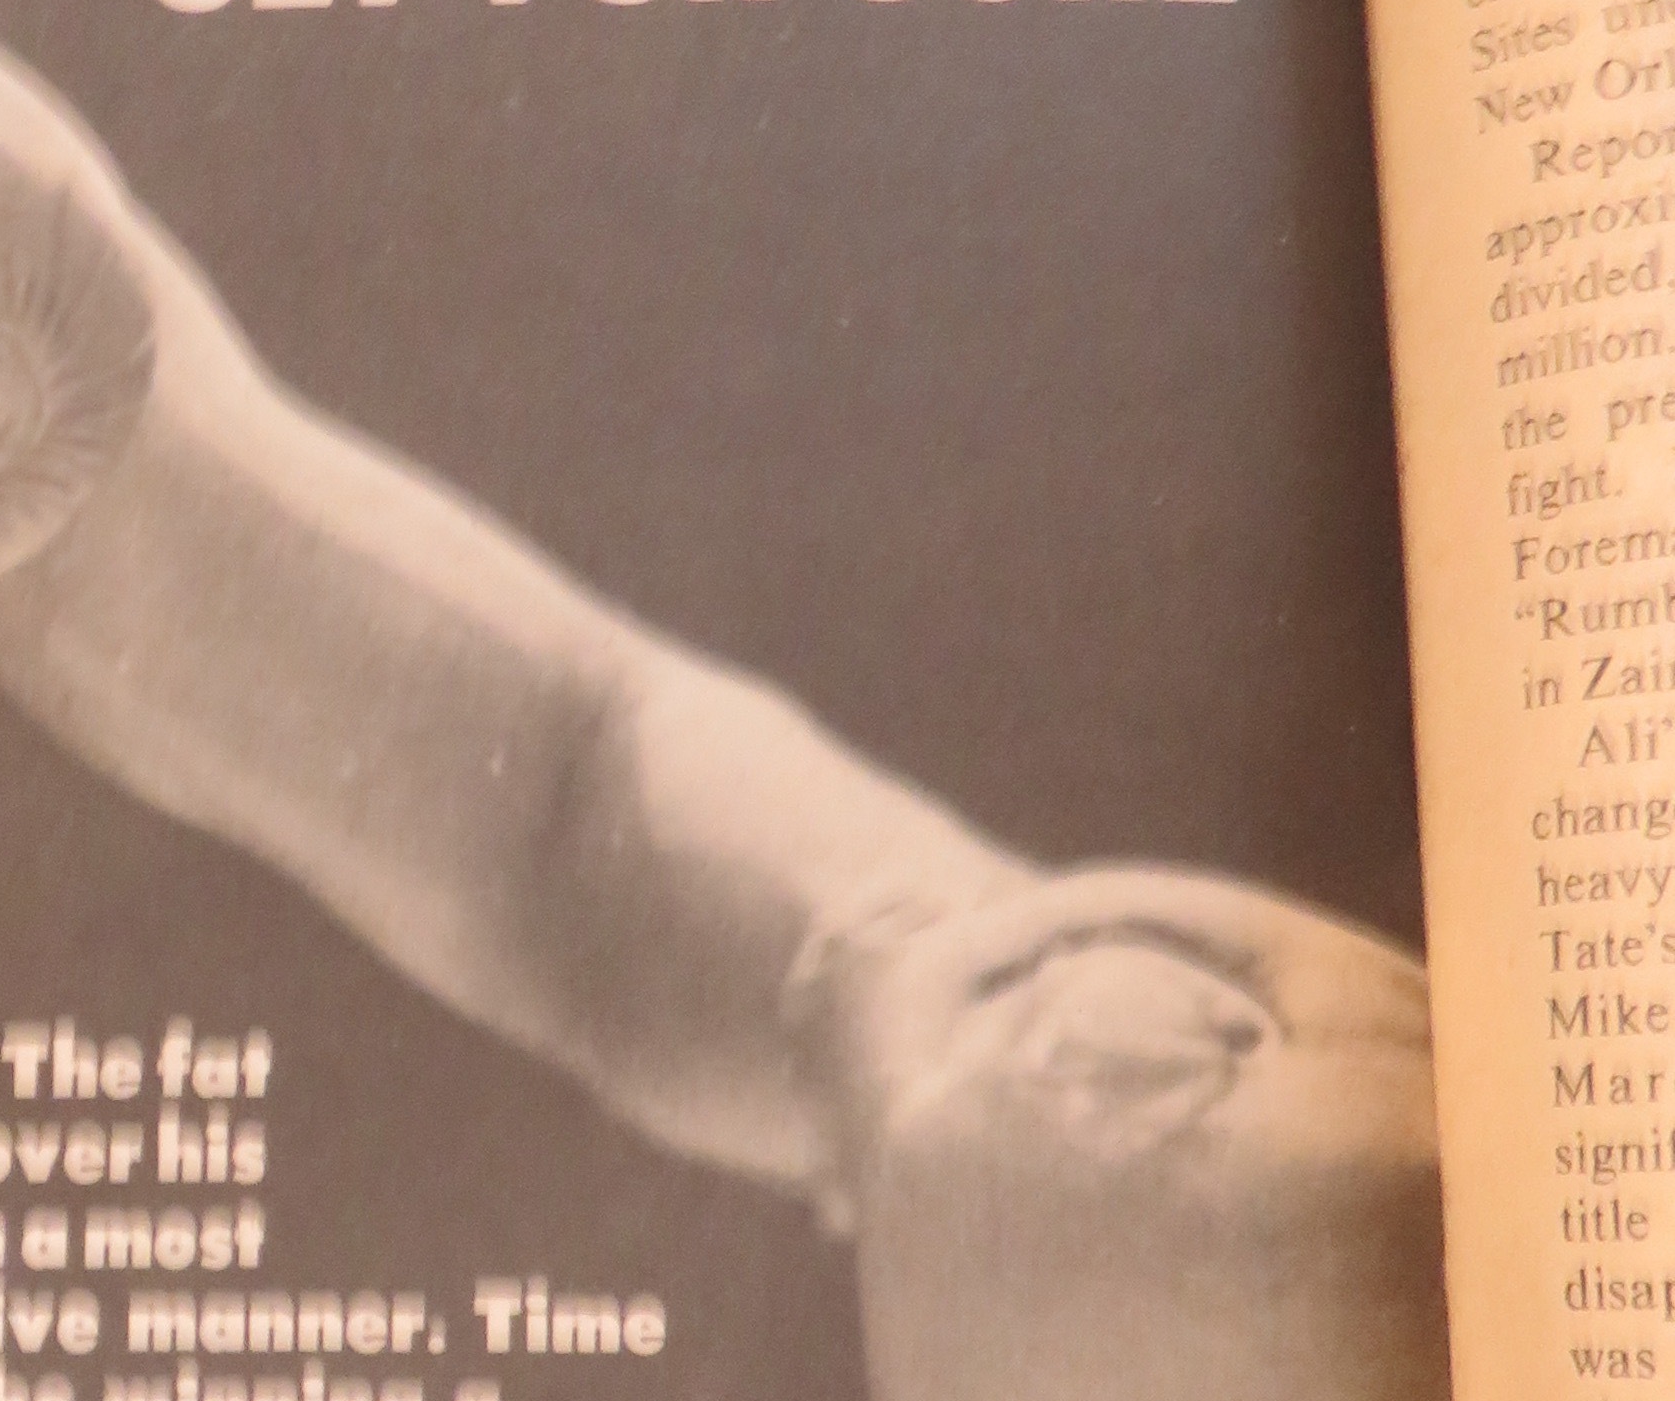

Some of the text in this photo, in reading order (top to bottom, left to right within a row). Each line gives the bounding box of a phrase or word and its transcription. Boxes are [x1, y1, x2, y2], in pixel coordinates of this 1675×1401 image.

[1471, 15, 1577, 74] Sites
[1472, 83, 1574, 135] New
[1502, 406, 1568, 450] the
[1507, 462, 1622, 522] fight.
[1522, 667, 1562, 710] in
[1536, 863, 1675, 908] heavy
[1546, 994, 1669, 1040] Mike
[2, 1014, 142, 1100] The
[158, 1014, 272, 1100] fat
[158, 1100, 267, 1184] his
[21, 1204, 68, 1270] a
[84, 1196, 265, 1270] most
[1560, 1198, 1650, 1243] title
[126, 1288, 447, 1355] manner.
[474, 1274, 666, 1356] Time
[1570, 1347, 1657, 1379] was
